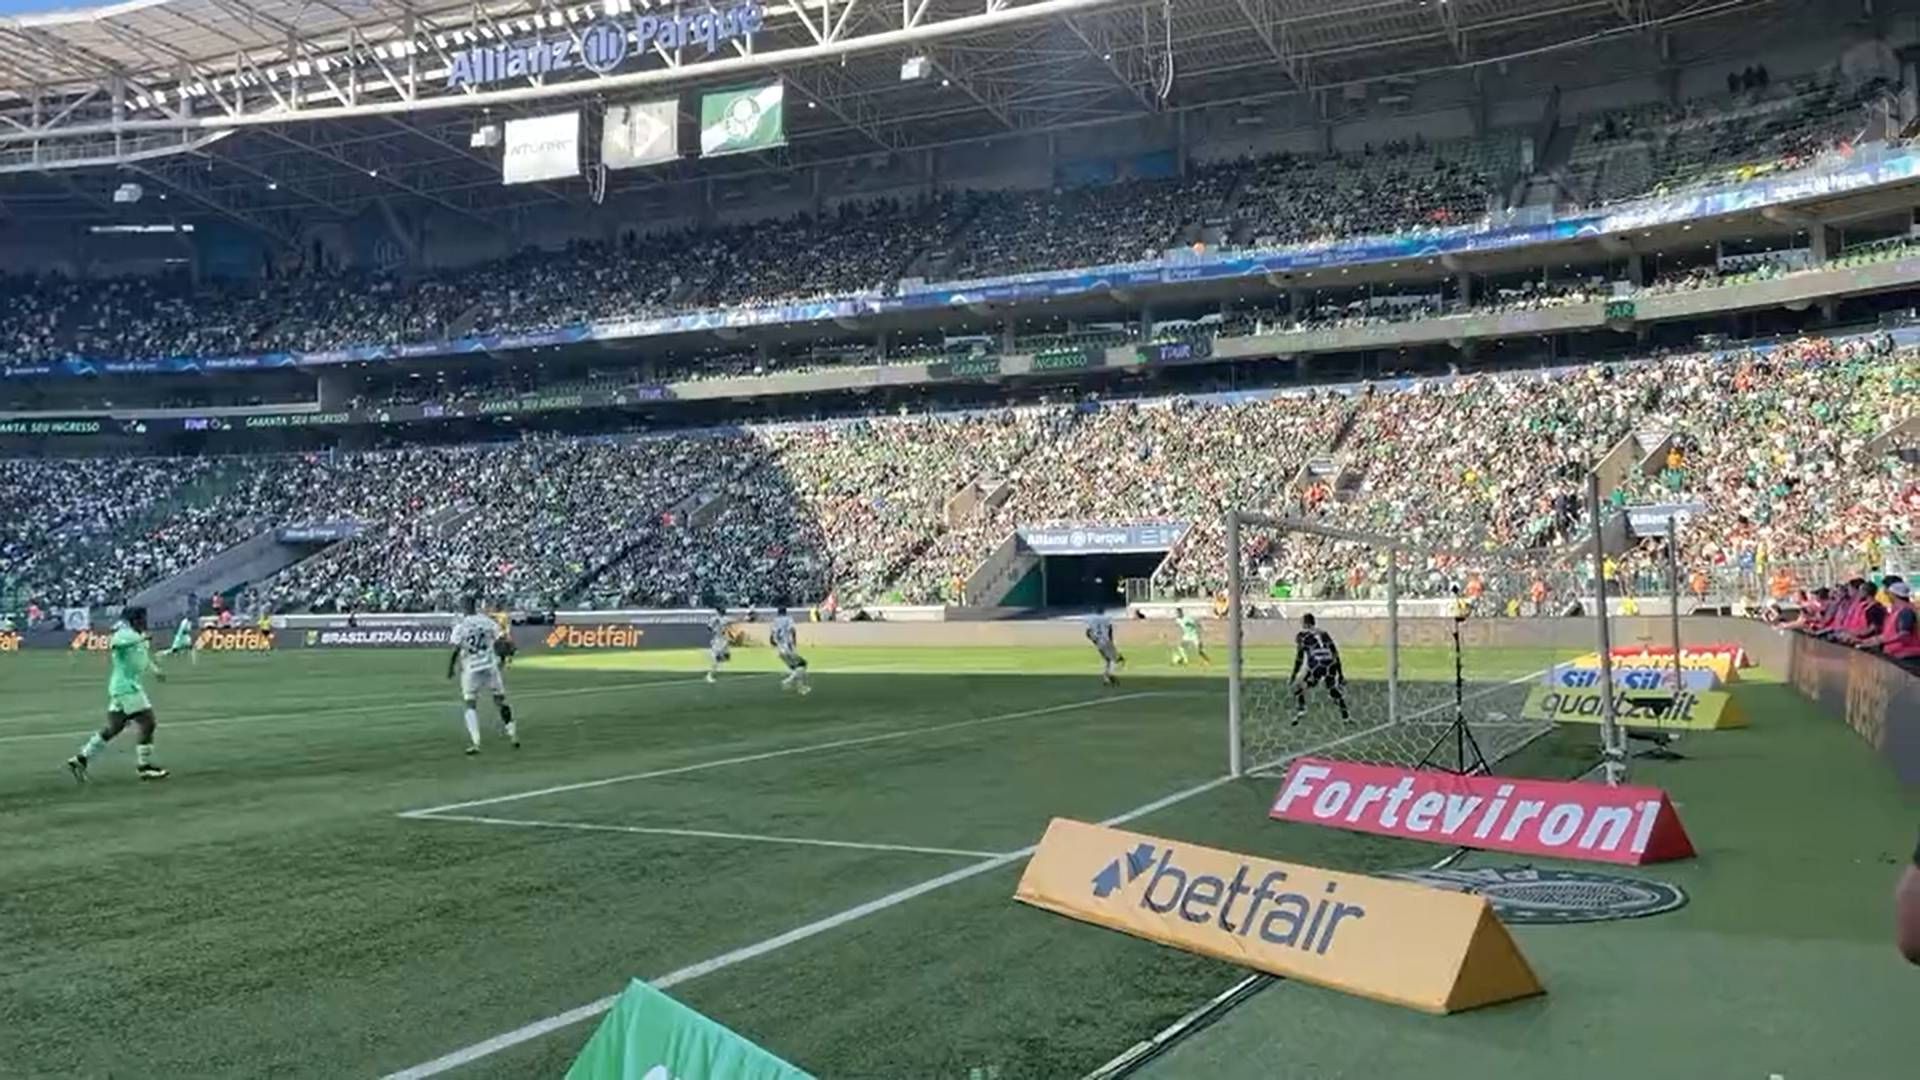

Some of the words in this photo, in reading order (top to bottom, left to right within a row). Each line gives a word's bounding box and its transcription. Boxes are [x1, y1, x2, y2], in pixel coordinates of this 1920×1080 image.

[447, 40, 573, 87] Allianz
[634, 3, 765, 52] Parque
[30, 421, 49, 432] SEU
[51, 420, 99, 432] INGRESSO
[1027, 533, 1068, 545] Allianz
[1087, 531, 1127, 545] Parque
[213, 629, 275, 649] betfa
[321, 627, 412, 644] BRASILEIRÃO
[568, 626, 643, 647] betfair
[1140, 849, 1366, 956] betfair
